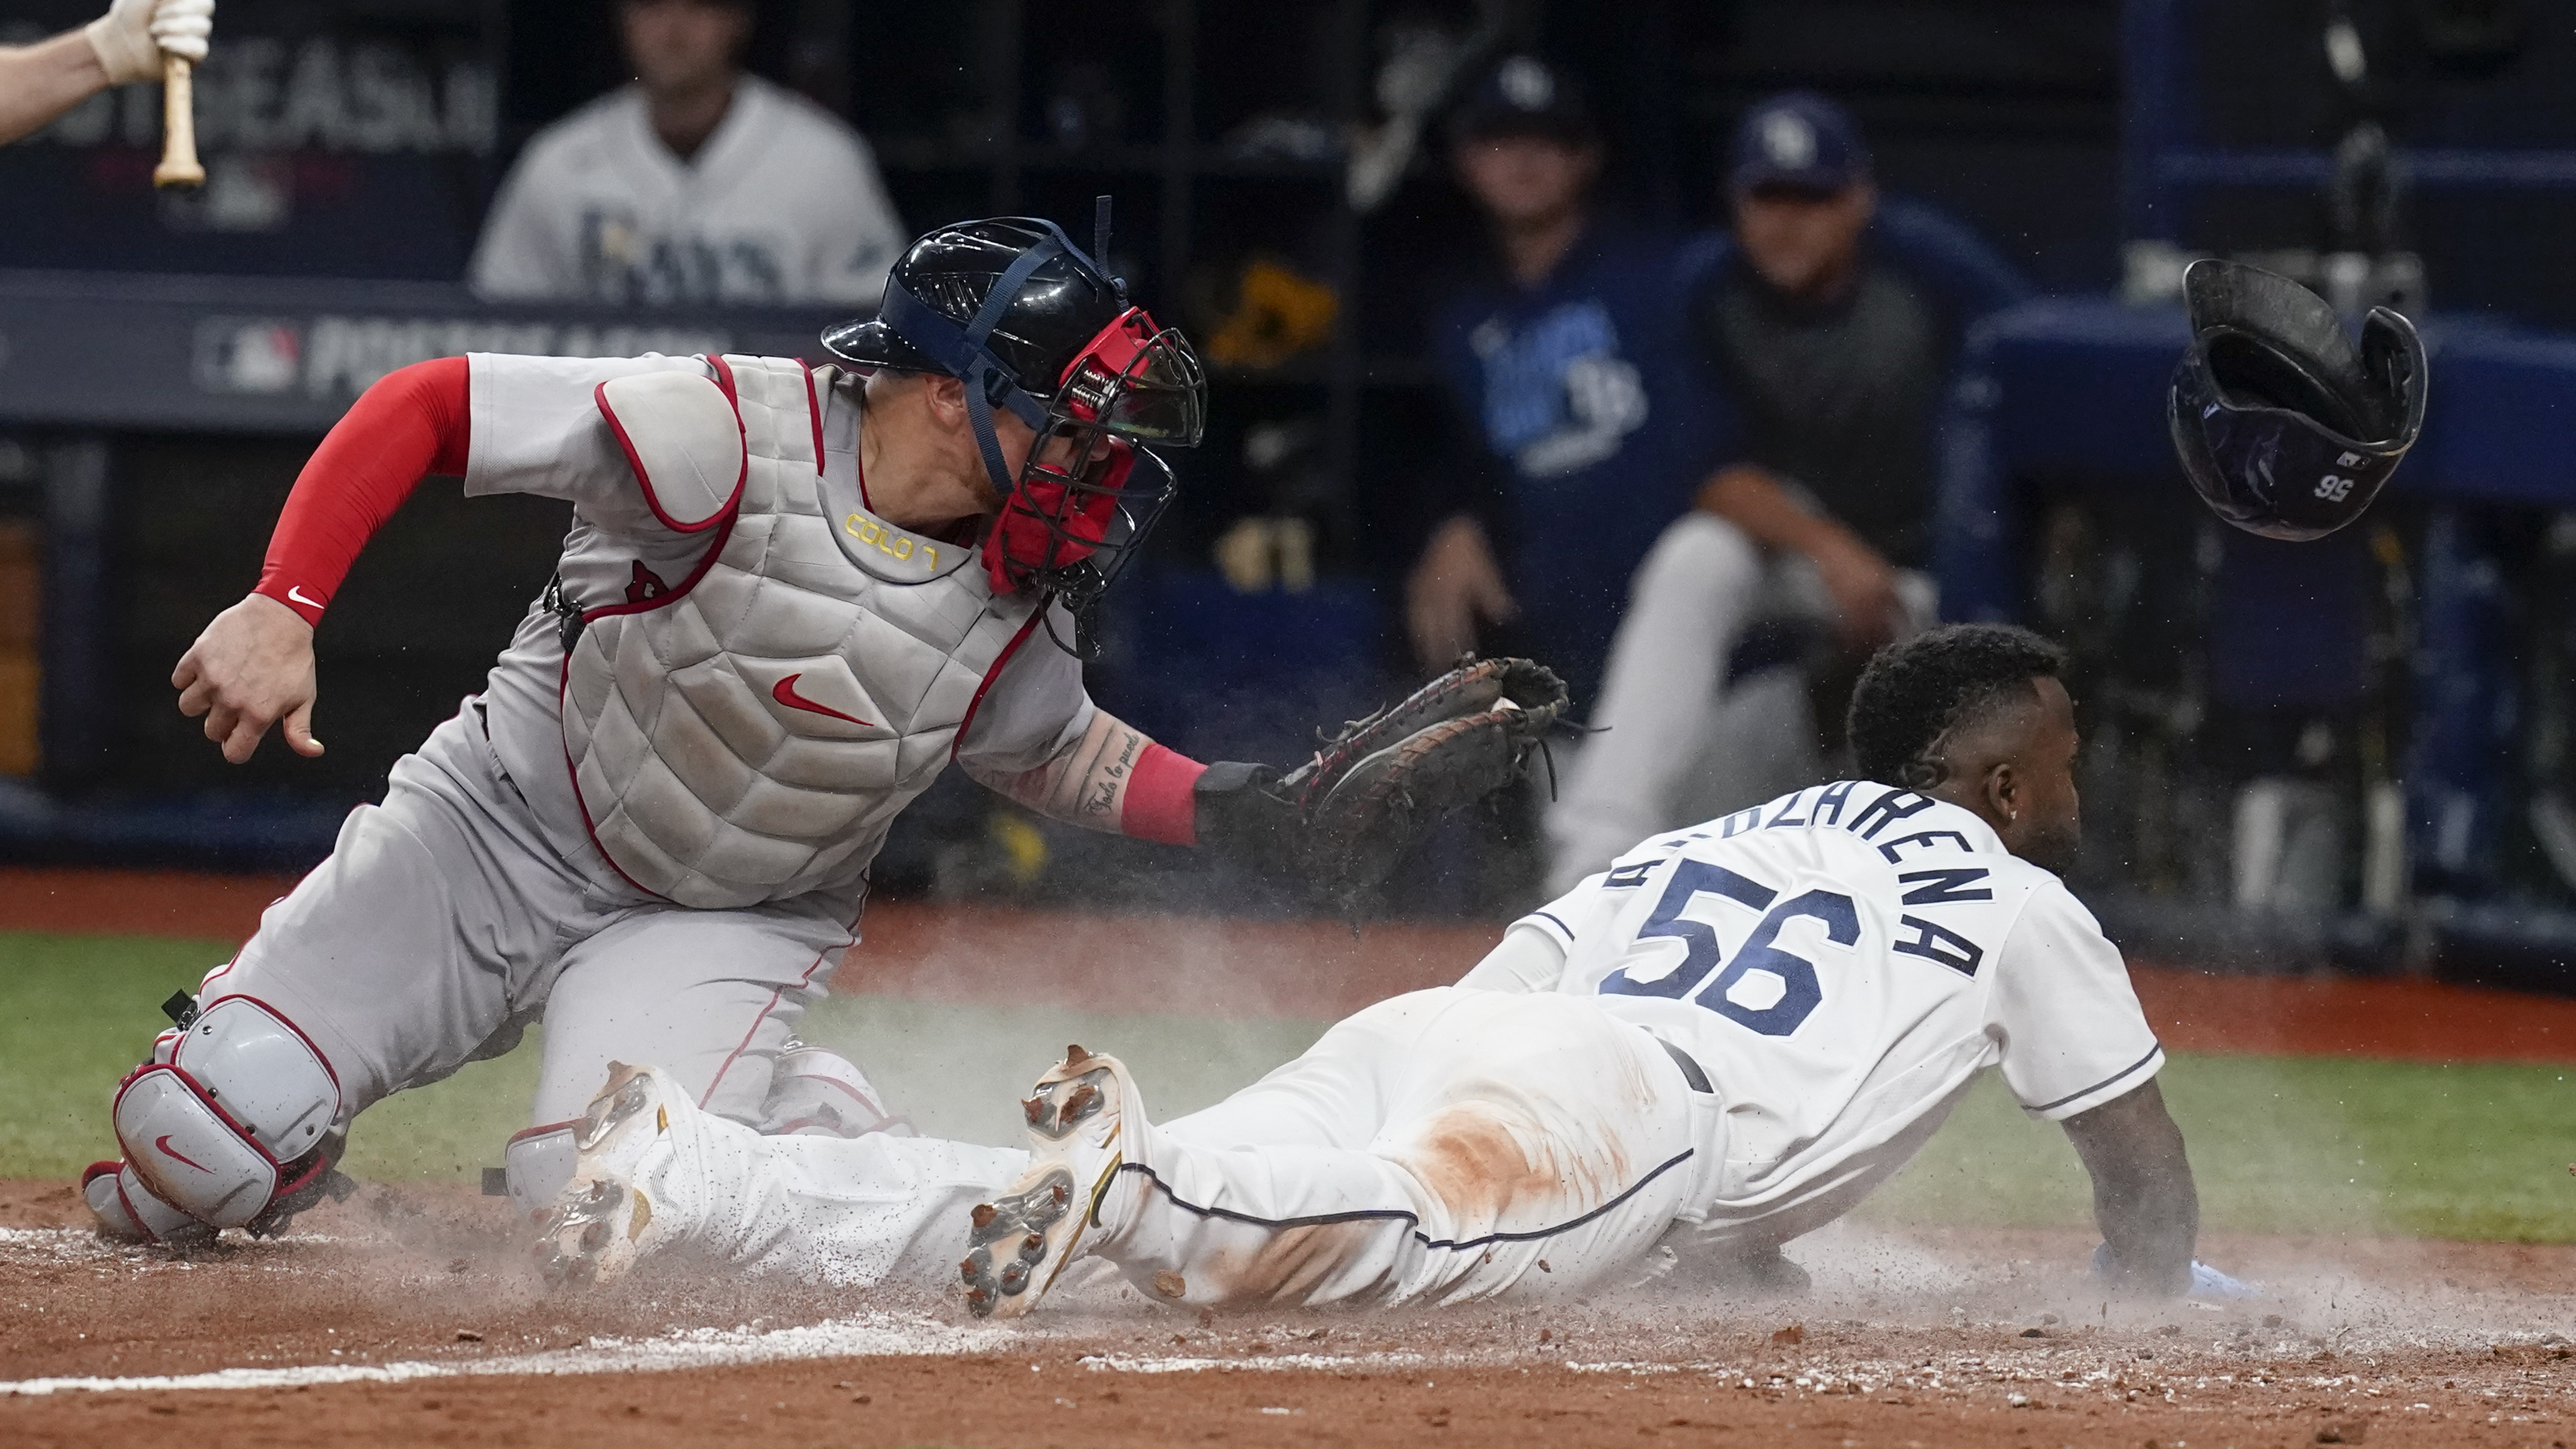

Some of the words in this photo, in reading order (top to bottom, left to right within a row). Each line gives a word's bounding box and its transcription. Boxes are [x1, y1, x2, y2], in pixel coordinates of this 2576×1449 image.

[845, 513, 913, 561] COLO
[1105, 764, 1124, 779] lo
[1597, 856, 1864, 1039] 56
